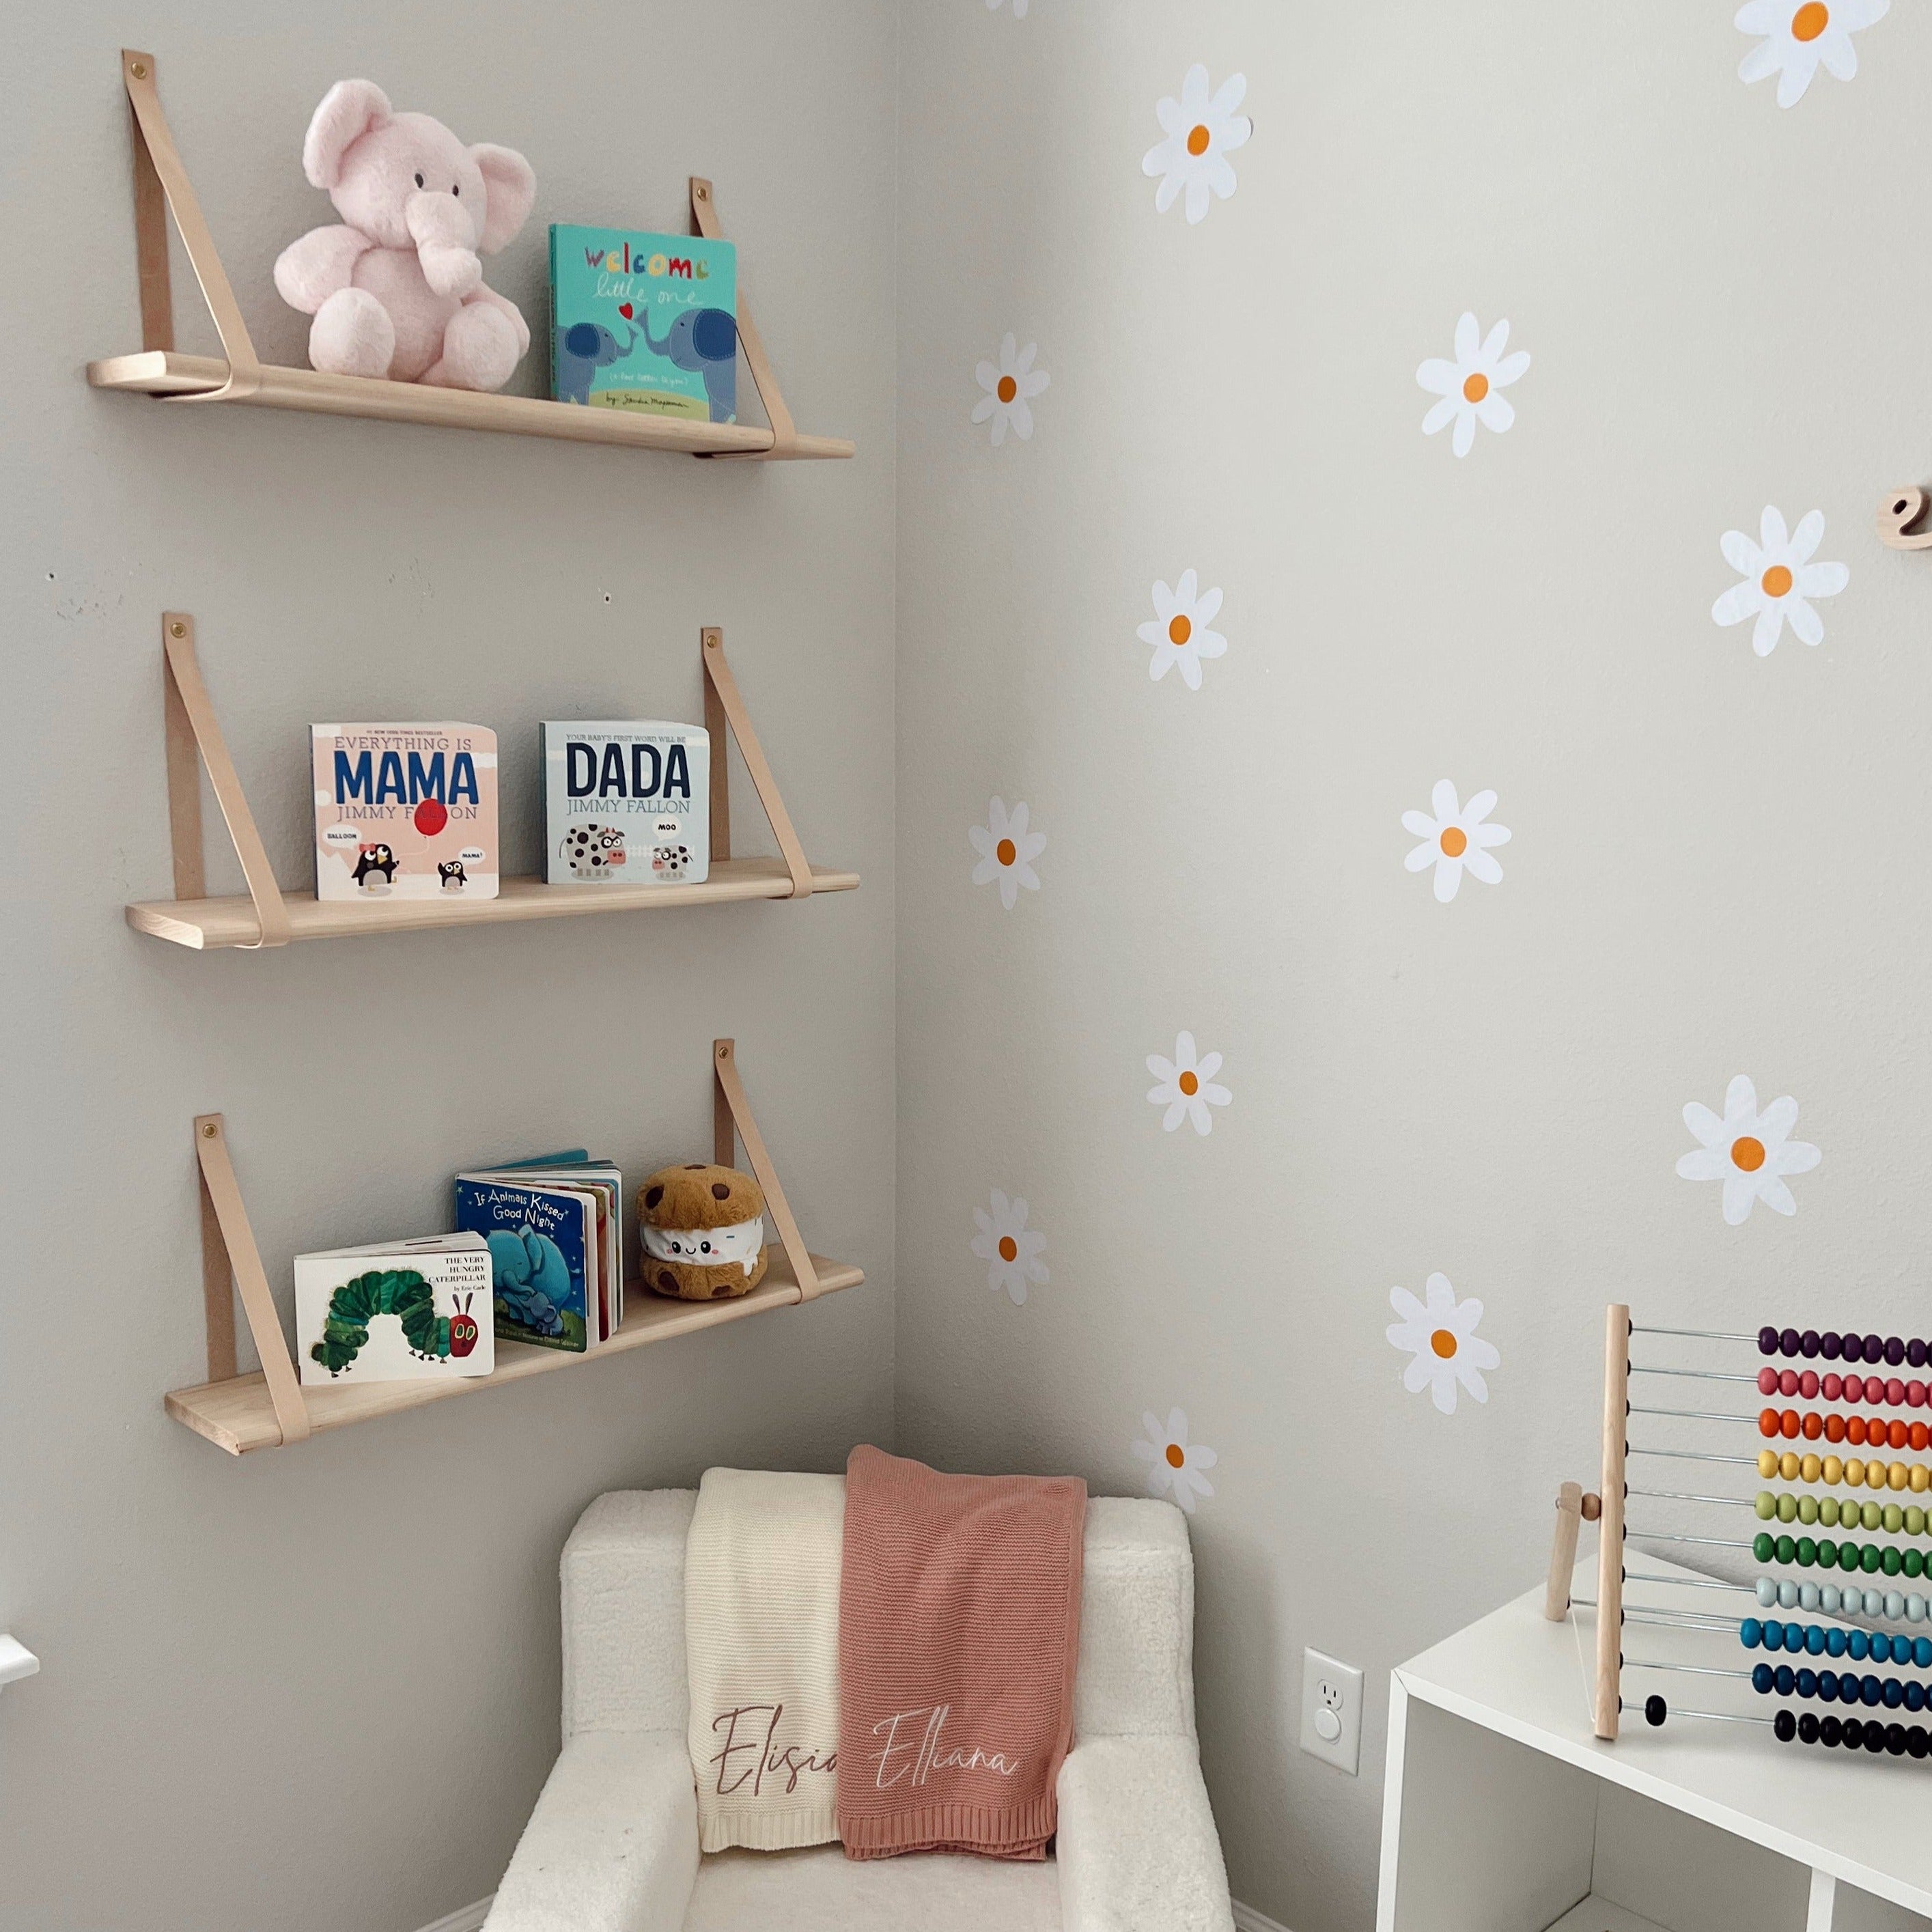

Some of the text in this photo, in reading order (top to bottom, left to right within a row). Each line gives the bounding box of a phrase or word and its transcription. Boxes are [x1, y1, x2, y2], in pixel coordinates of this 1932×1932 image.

[585, 242, 710, 280] welcome
[592, 272, 703, 305] little one
[335, 736, 472, 751] EVERYTHING IS
[334, 751, 479, 804] MAMA
[566, 742, 690, 798] DADA
[337, 807, 396, 822] JIMMY
[567, 800, 690, 815] JIMMY FALLON
[474, 1192, 486, 1206] If
[530, 1194, 565, 1221] Kissed
[493, 1205, 555, 1231] Good Night
[428, 1275, 486, 1283] CATERPILLAR
[871, 1705, 1018, 1788] Elliana
